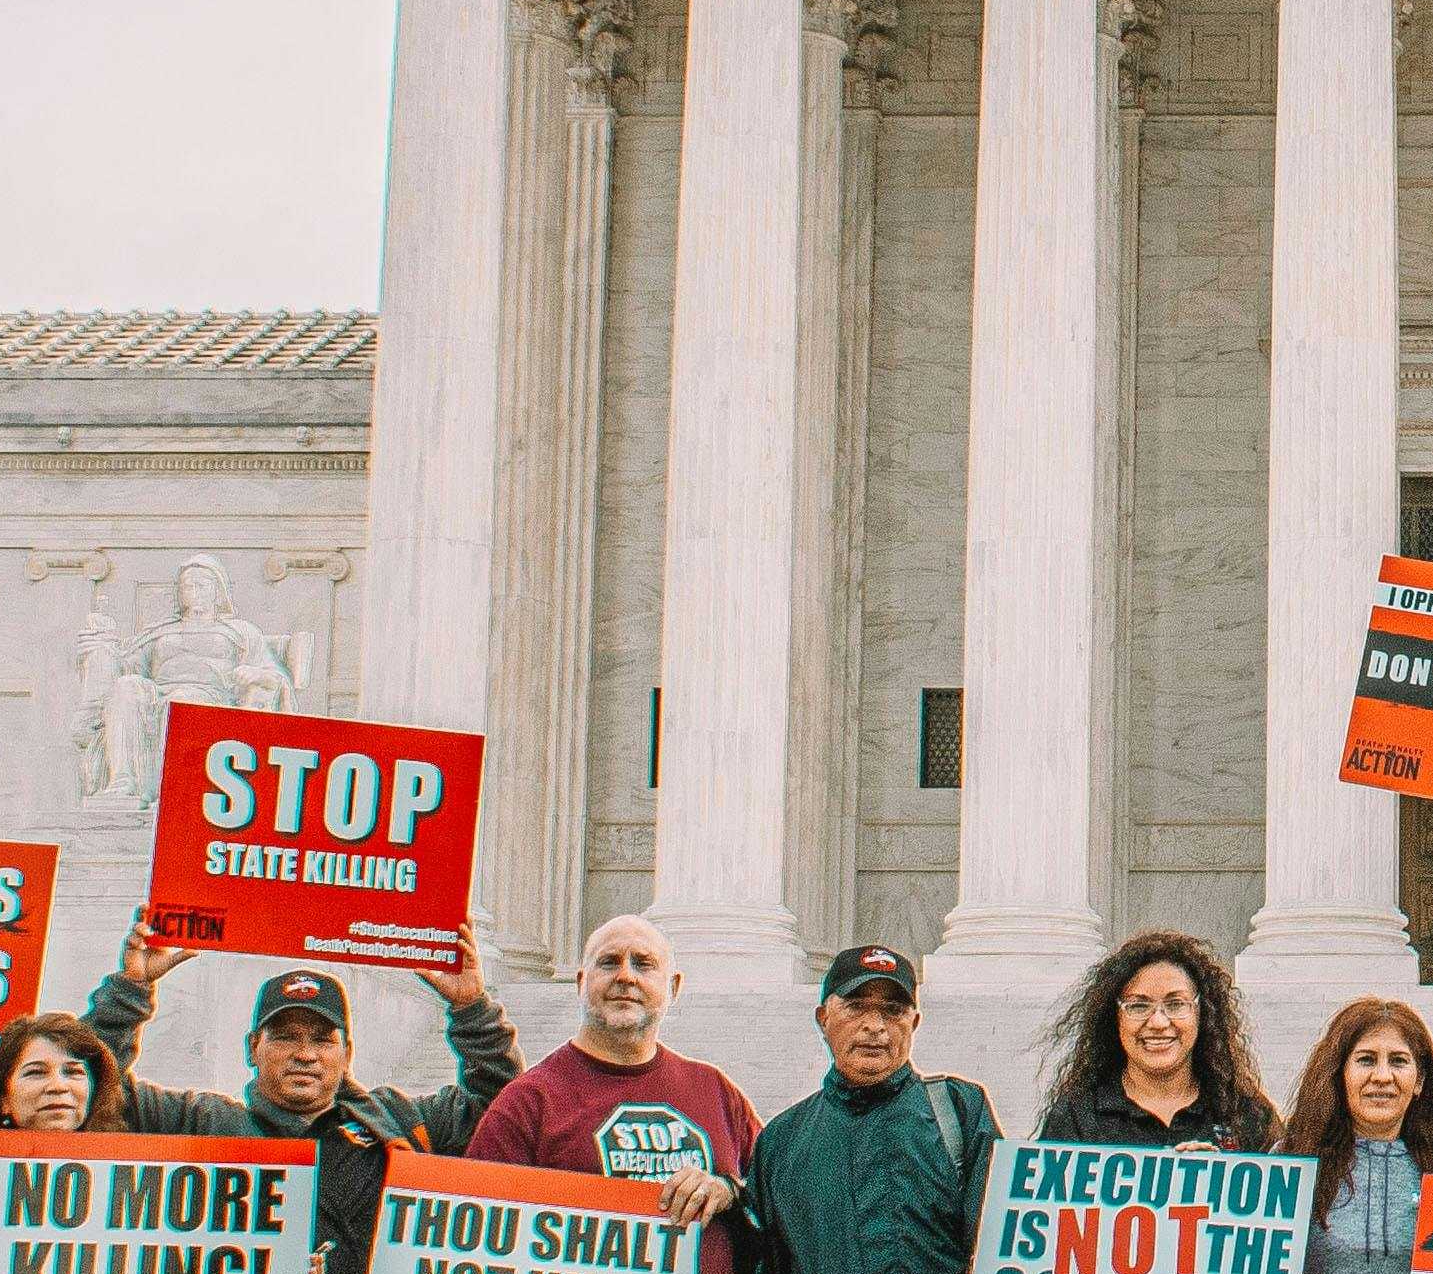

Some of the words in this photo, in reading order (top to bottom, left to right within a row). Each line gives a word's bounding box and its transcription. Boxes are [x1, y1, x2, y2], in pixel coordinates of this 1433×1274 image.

[1388, 588, 1396, 606] I
[1346, 746, 1420, 780] ACTION
[202, 739, 443, 846] STOP
[205, 841, 299, 882] STATE
[303, 850, 417, 893] KILLING
[613, 1120, 688, 1151] STOP
[4, 1162, 94, 1229] NO
[105, 1165, 287, 1234] MORE
[1008, 1147, 1301, 1219] EXECUTION
[386, 1193, 521, 1257] THOU
[529, 1210, 686, 1274] SHALT
[998, 1208, 1050, 1260] IS
